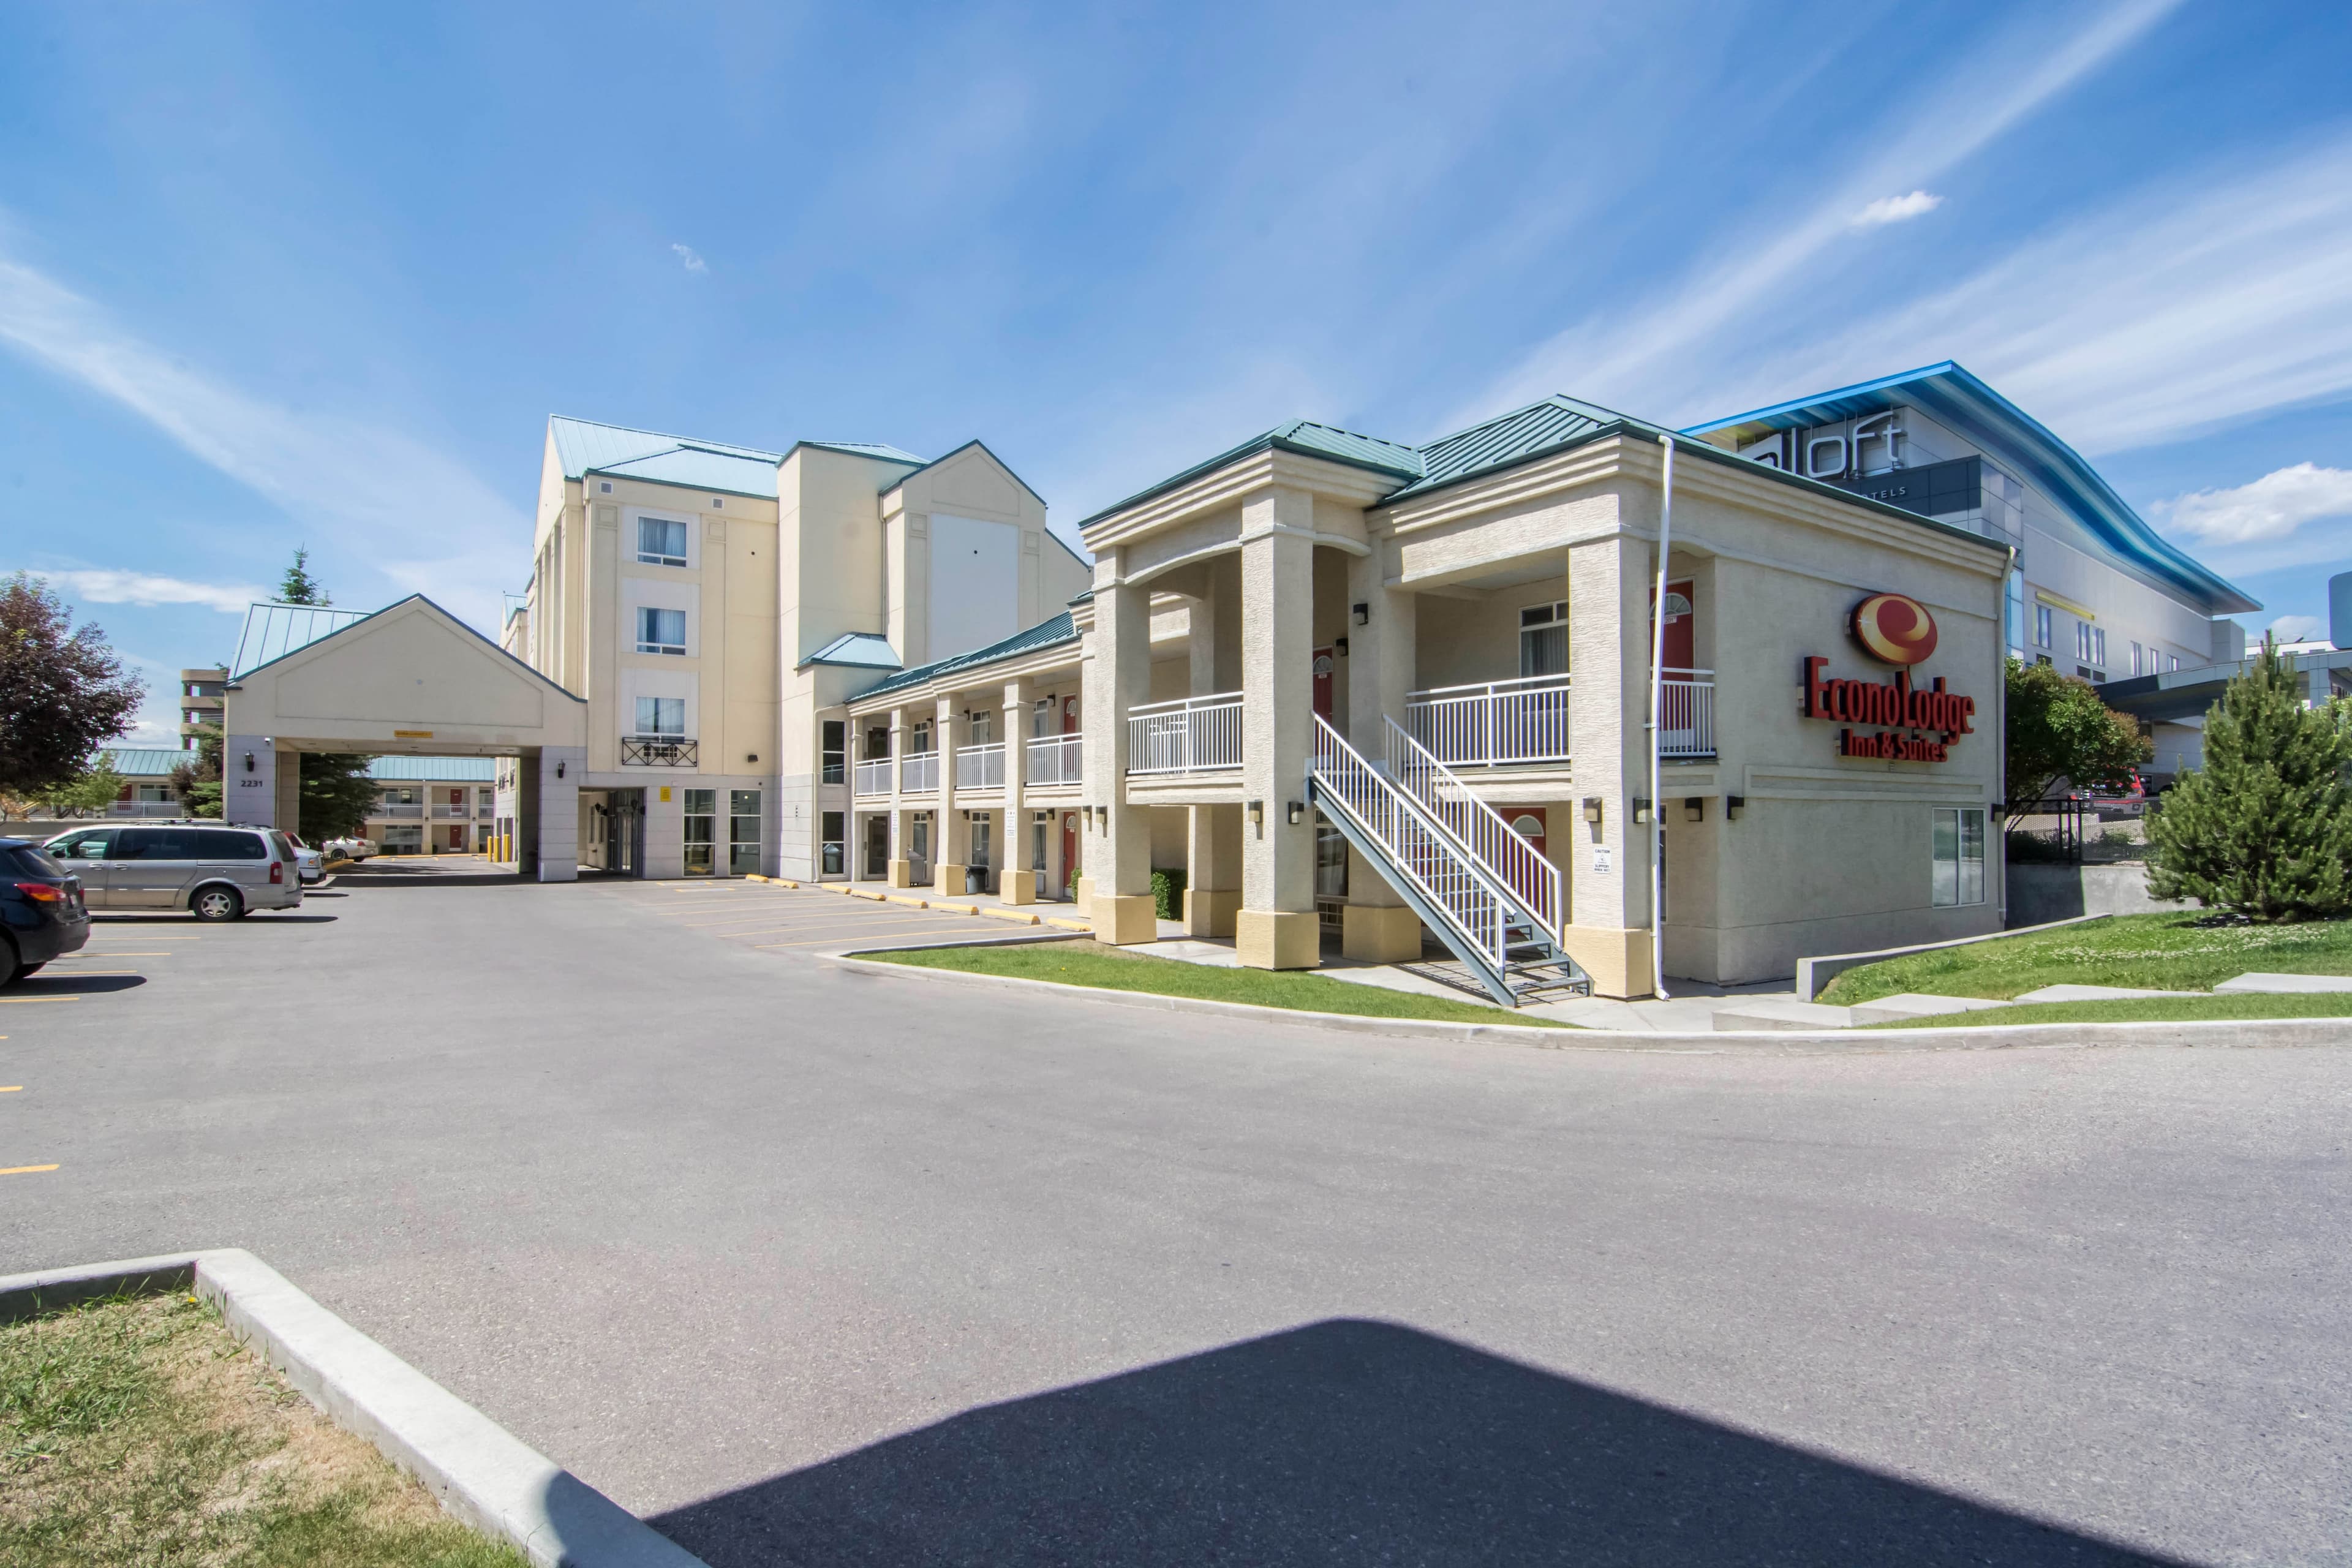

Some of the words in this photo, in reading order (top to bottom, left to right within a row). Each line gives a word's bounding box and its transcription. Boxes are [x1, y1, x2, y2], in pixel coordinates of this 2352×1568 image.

[1862, 486, 1906, 500] TELS
[1842, 728, 1878, 758] Inn
[1880, 731, 1894, 760] &
[1897, 733, 1948, 762] Suites
